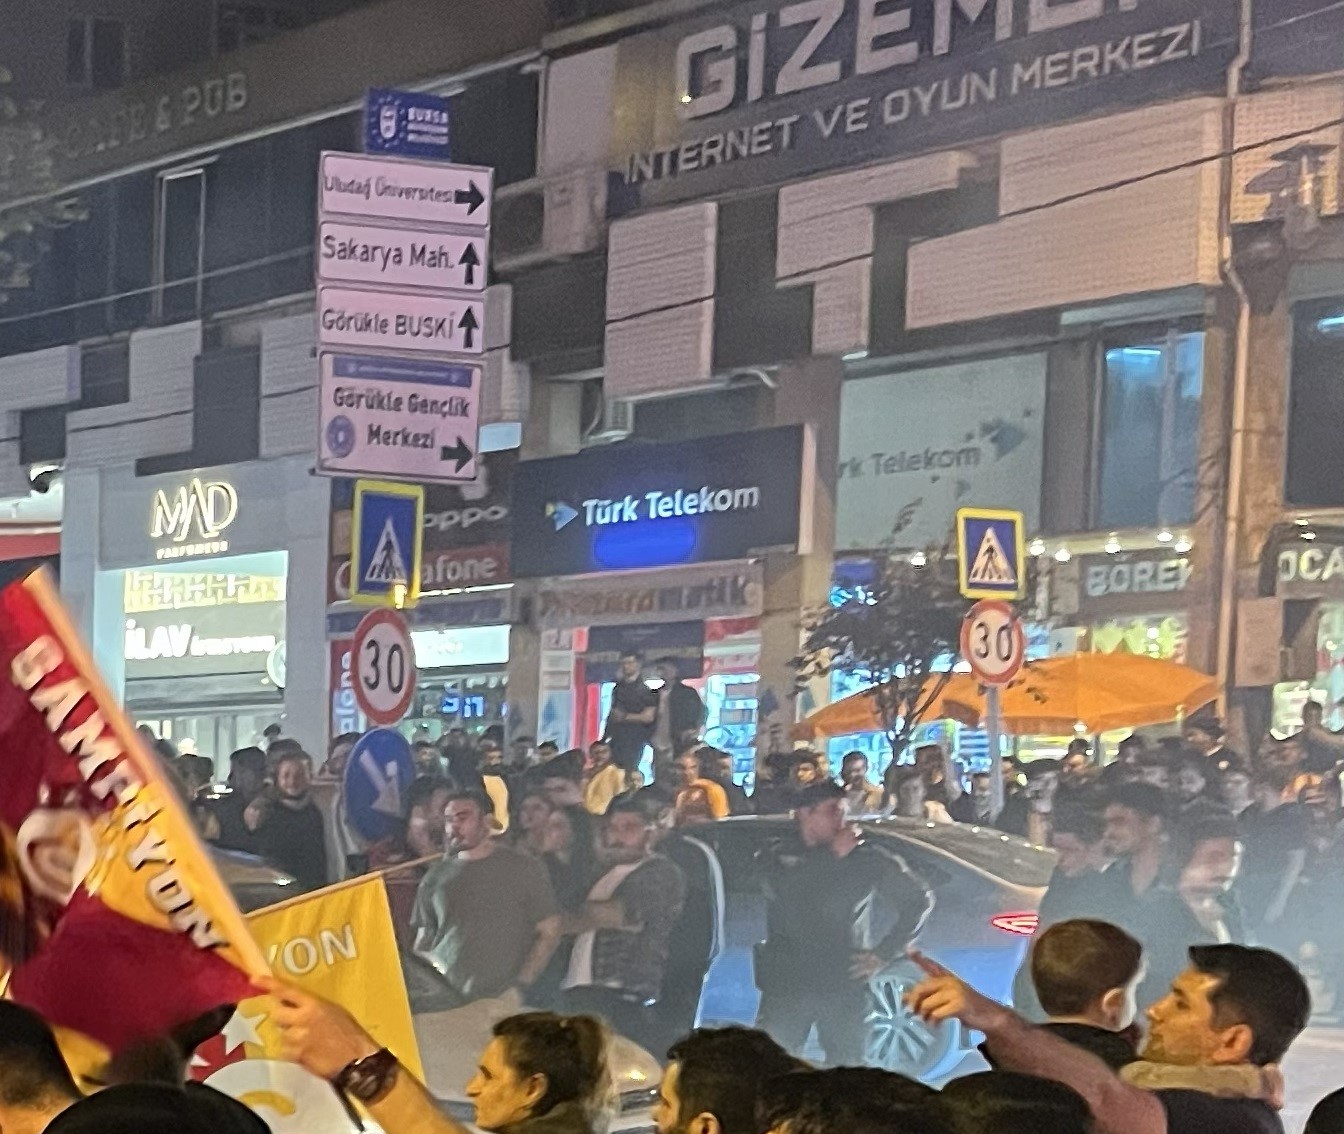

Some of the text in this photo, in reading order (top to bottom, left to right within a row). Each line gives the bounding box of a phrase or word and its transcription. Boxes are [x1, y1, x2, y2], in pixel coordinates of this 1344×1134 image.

[180, 73, 247, 126] PUB
[814, 97, 872, 138] VE
[883, 68, 997, 125] OYUN
[323, 235, 454, 272] Sakarya Mah.
[322, 308, 456, 339] Görükle BUSKİ
[333, 386, 469, 418] Görükle Gençlik
[367, 423, 436, 449] Merkezi
[871, 447, 982, 477] Telekom
[150, 477, 238, 541] MAD
[582, 486, 760, 526] Türk Telekom
[974, 622, 1013, 663] 30
[364, 639, 404, 694] 30
